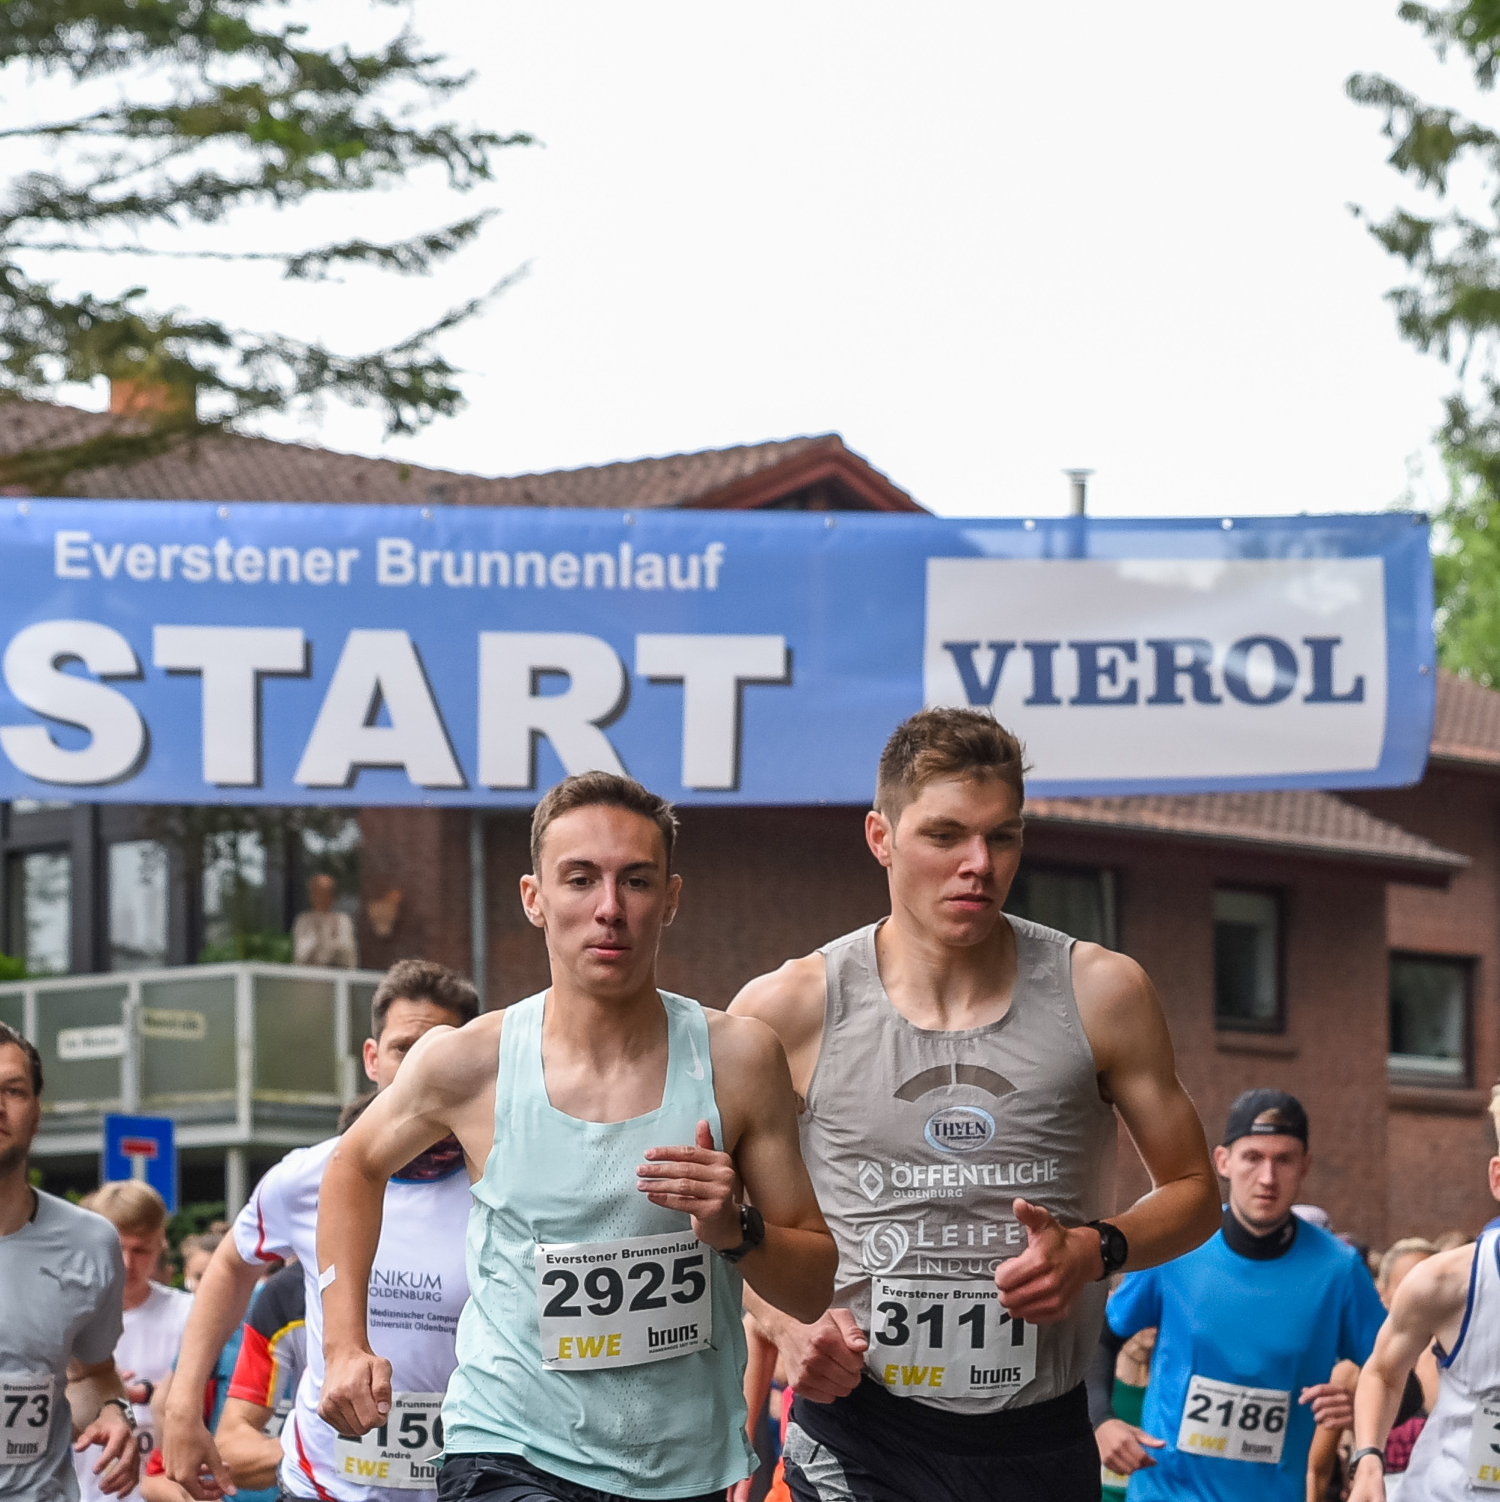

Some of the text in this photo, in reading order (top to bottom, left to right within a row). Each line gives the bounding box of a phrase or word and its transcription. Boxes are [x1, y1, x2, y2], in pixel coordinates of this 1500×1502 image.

[54, 531, 724, 592] Everstener Brunnenlauf
[942, 635, 1365, 709] VIEROL
[932, 1121, 986, 1136] THYEN
[891, 1158, 1060, 1187] ÖFFENTLICHE
[893, 1188, 964, 1199] OLDENBURG
[917, 1220, 1021, 1246] LEiFE
[546, 1239, 700, 1264] Everstener Brunnenlauf
[917, 1254, 1003, 1275] INDUC
[369, 1268, 442, 1290] INIKUM
[541, 1254, 706, 1317] 2925
[369, 1286, 442, 1302] OLDENBURG
[882, 1285, 998, 1299] Everstener Brunne
[370, 1307, 424, 1320] Medizinischer
[874, 1301, 1025, 1349] 3111
[370, 1318, 457, 1336] Universität Oldenburg
[558, 1323, 698, 1360] EWE bruns
[883, 1364, 1022, 1388] EWE bruns
[395, 1400, 442, 1409] Brunnenl
[1187, 1393, 1286, 1434] 2186
[337, 1413, 444, 1449] 15
[6, 1439, 39, 1455] bruns
[345, 1456, 441, 1479] EWE bru
